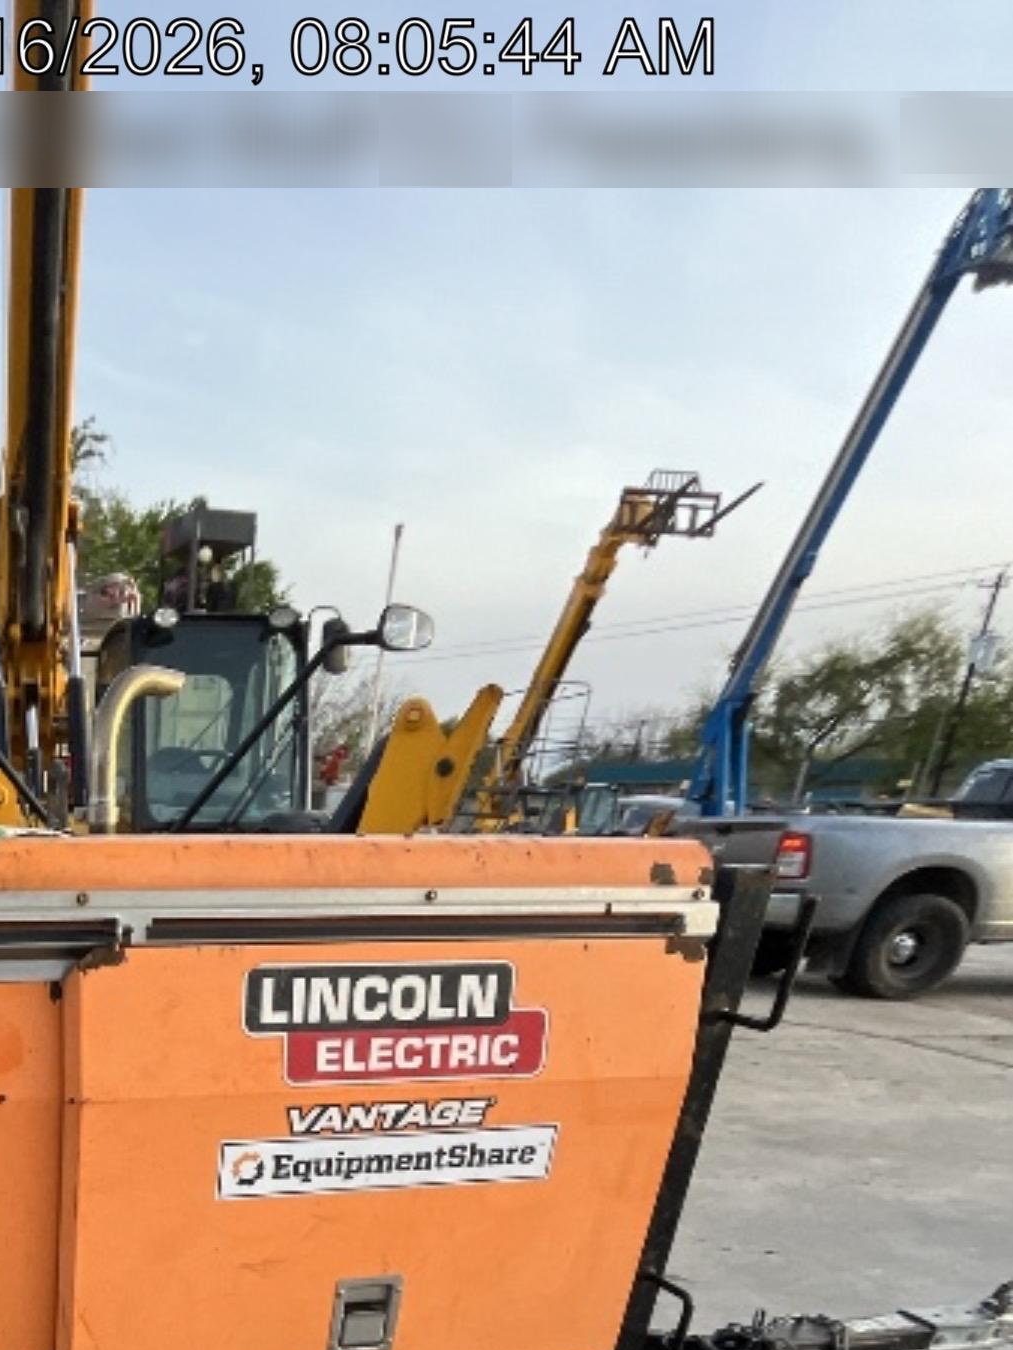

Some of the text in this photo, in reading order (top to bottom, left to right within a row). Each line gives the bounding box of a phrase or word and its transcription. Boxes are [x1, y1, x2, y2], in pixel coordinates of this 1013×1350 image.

[259, 974, 499, 1025] LINCOLN
[315, 1034, 520, 1073] ELECTRIC
[287, 1099, 491, 1134] VANTAGE
[271, 1142, 538, 1181] EquipmentShare
